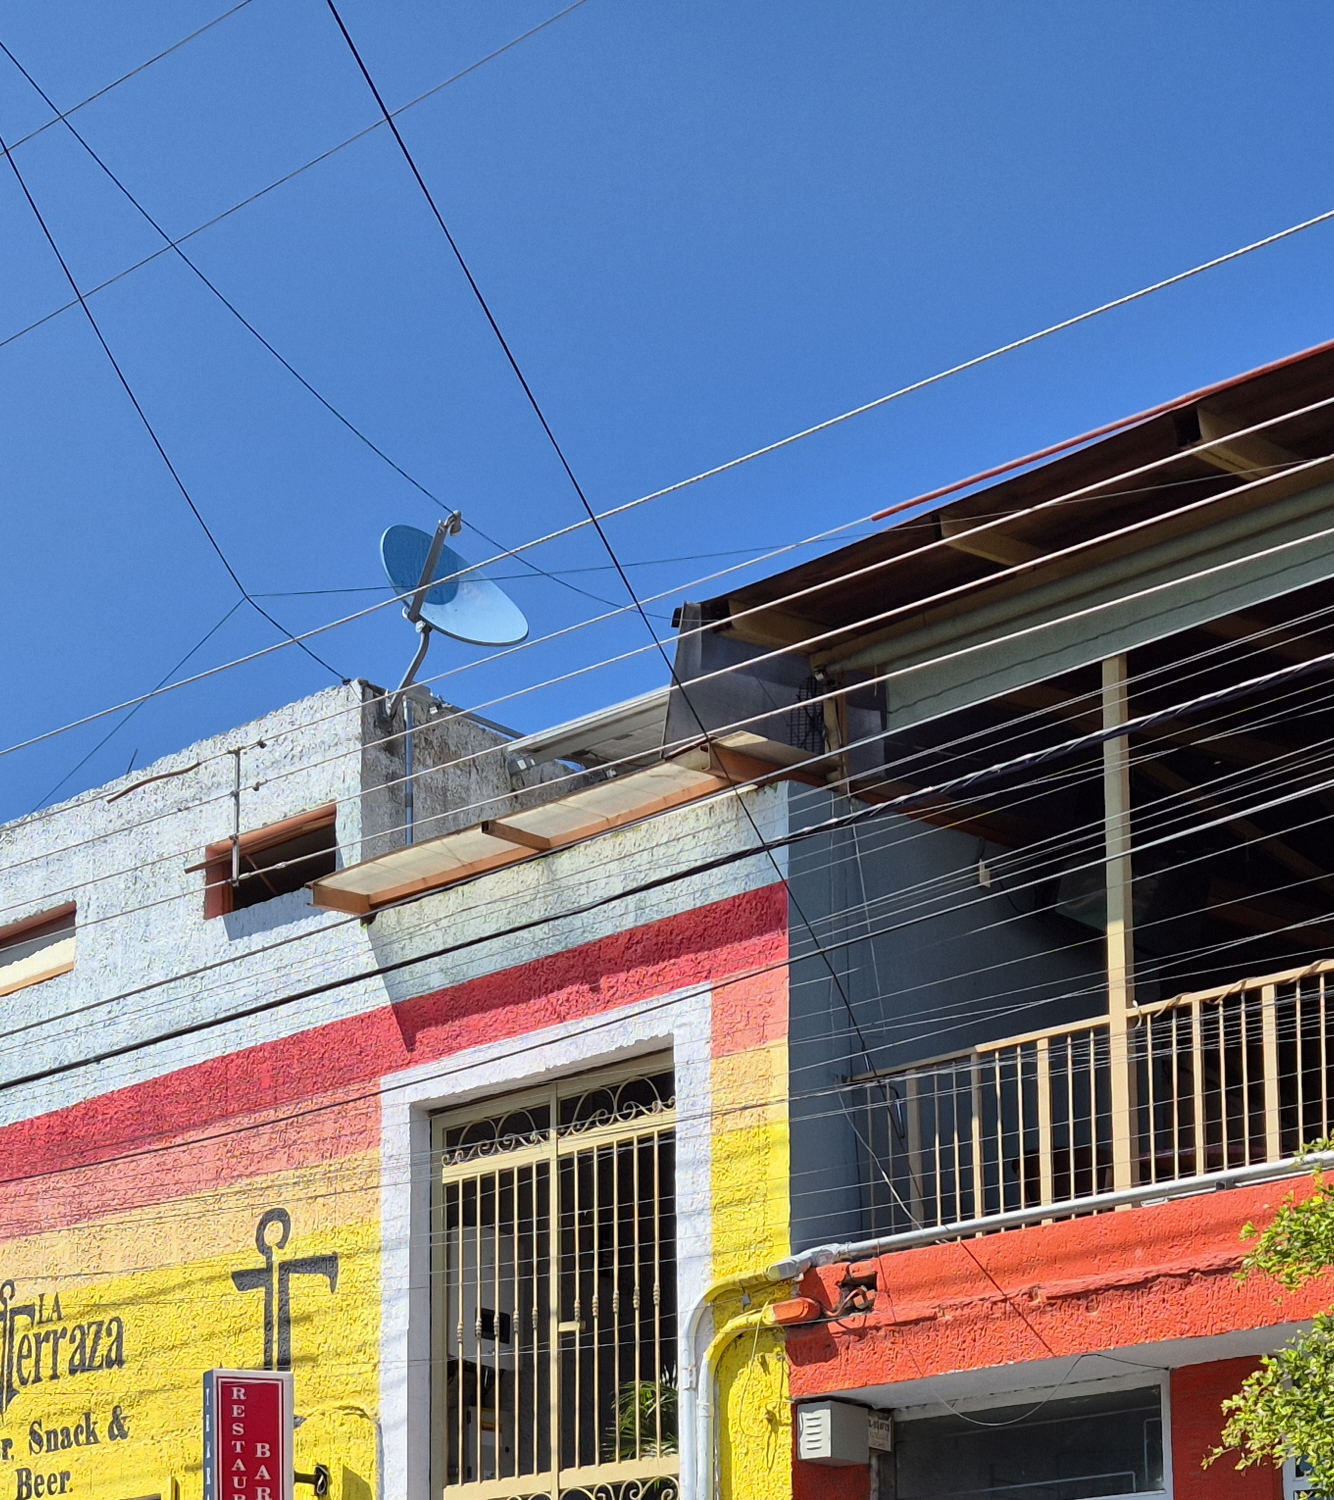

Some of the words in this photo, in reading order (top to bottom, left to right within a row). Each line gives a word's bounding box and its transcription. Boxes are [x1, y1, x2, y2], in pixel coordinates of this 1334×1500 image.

[37, 1291, 64, 1324] LA
[29, 1412, 101, 1456] Snack
[108, 1405, 132, 1441] &
